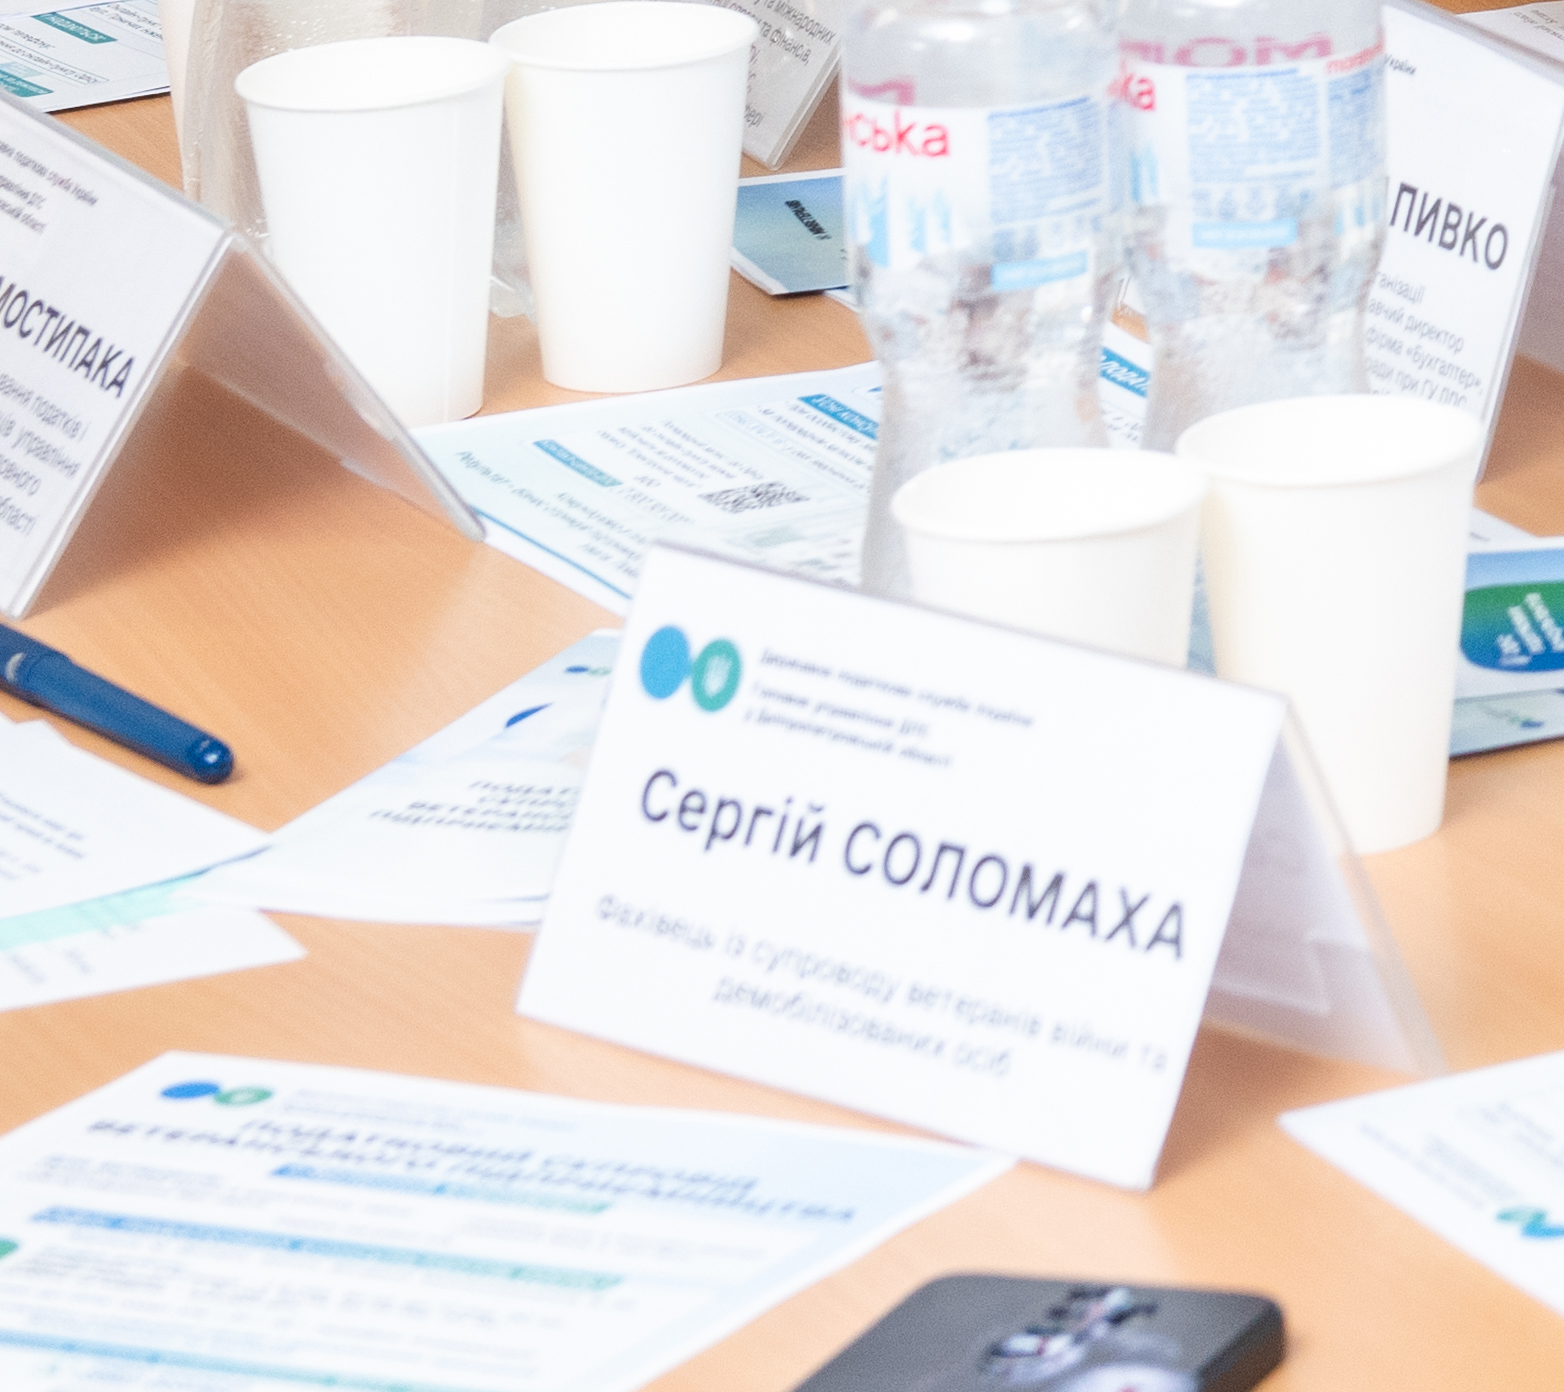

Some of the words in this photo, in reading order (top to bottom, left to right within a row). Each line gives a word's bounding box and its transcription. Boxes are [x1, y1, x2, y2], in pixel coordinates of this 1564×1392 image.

[1376, 270, 1426, 306] ганізації
[1368, 297, 1404, 326] авчий
[638, 765, 828, 868] Сергій
[842, 821, 1184, 963] СОЛОМАХА
